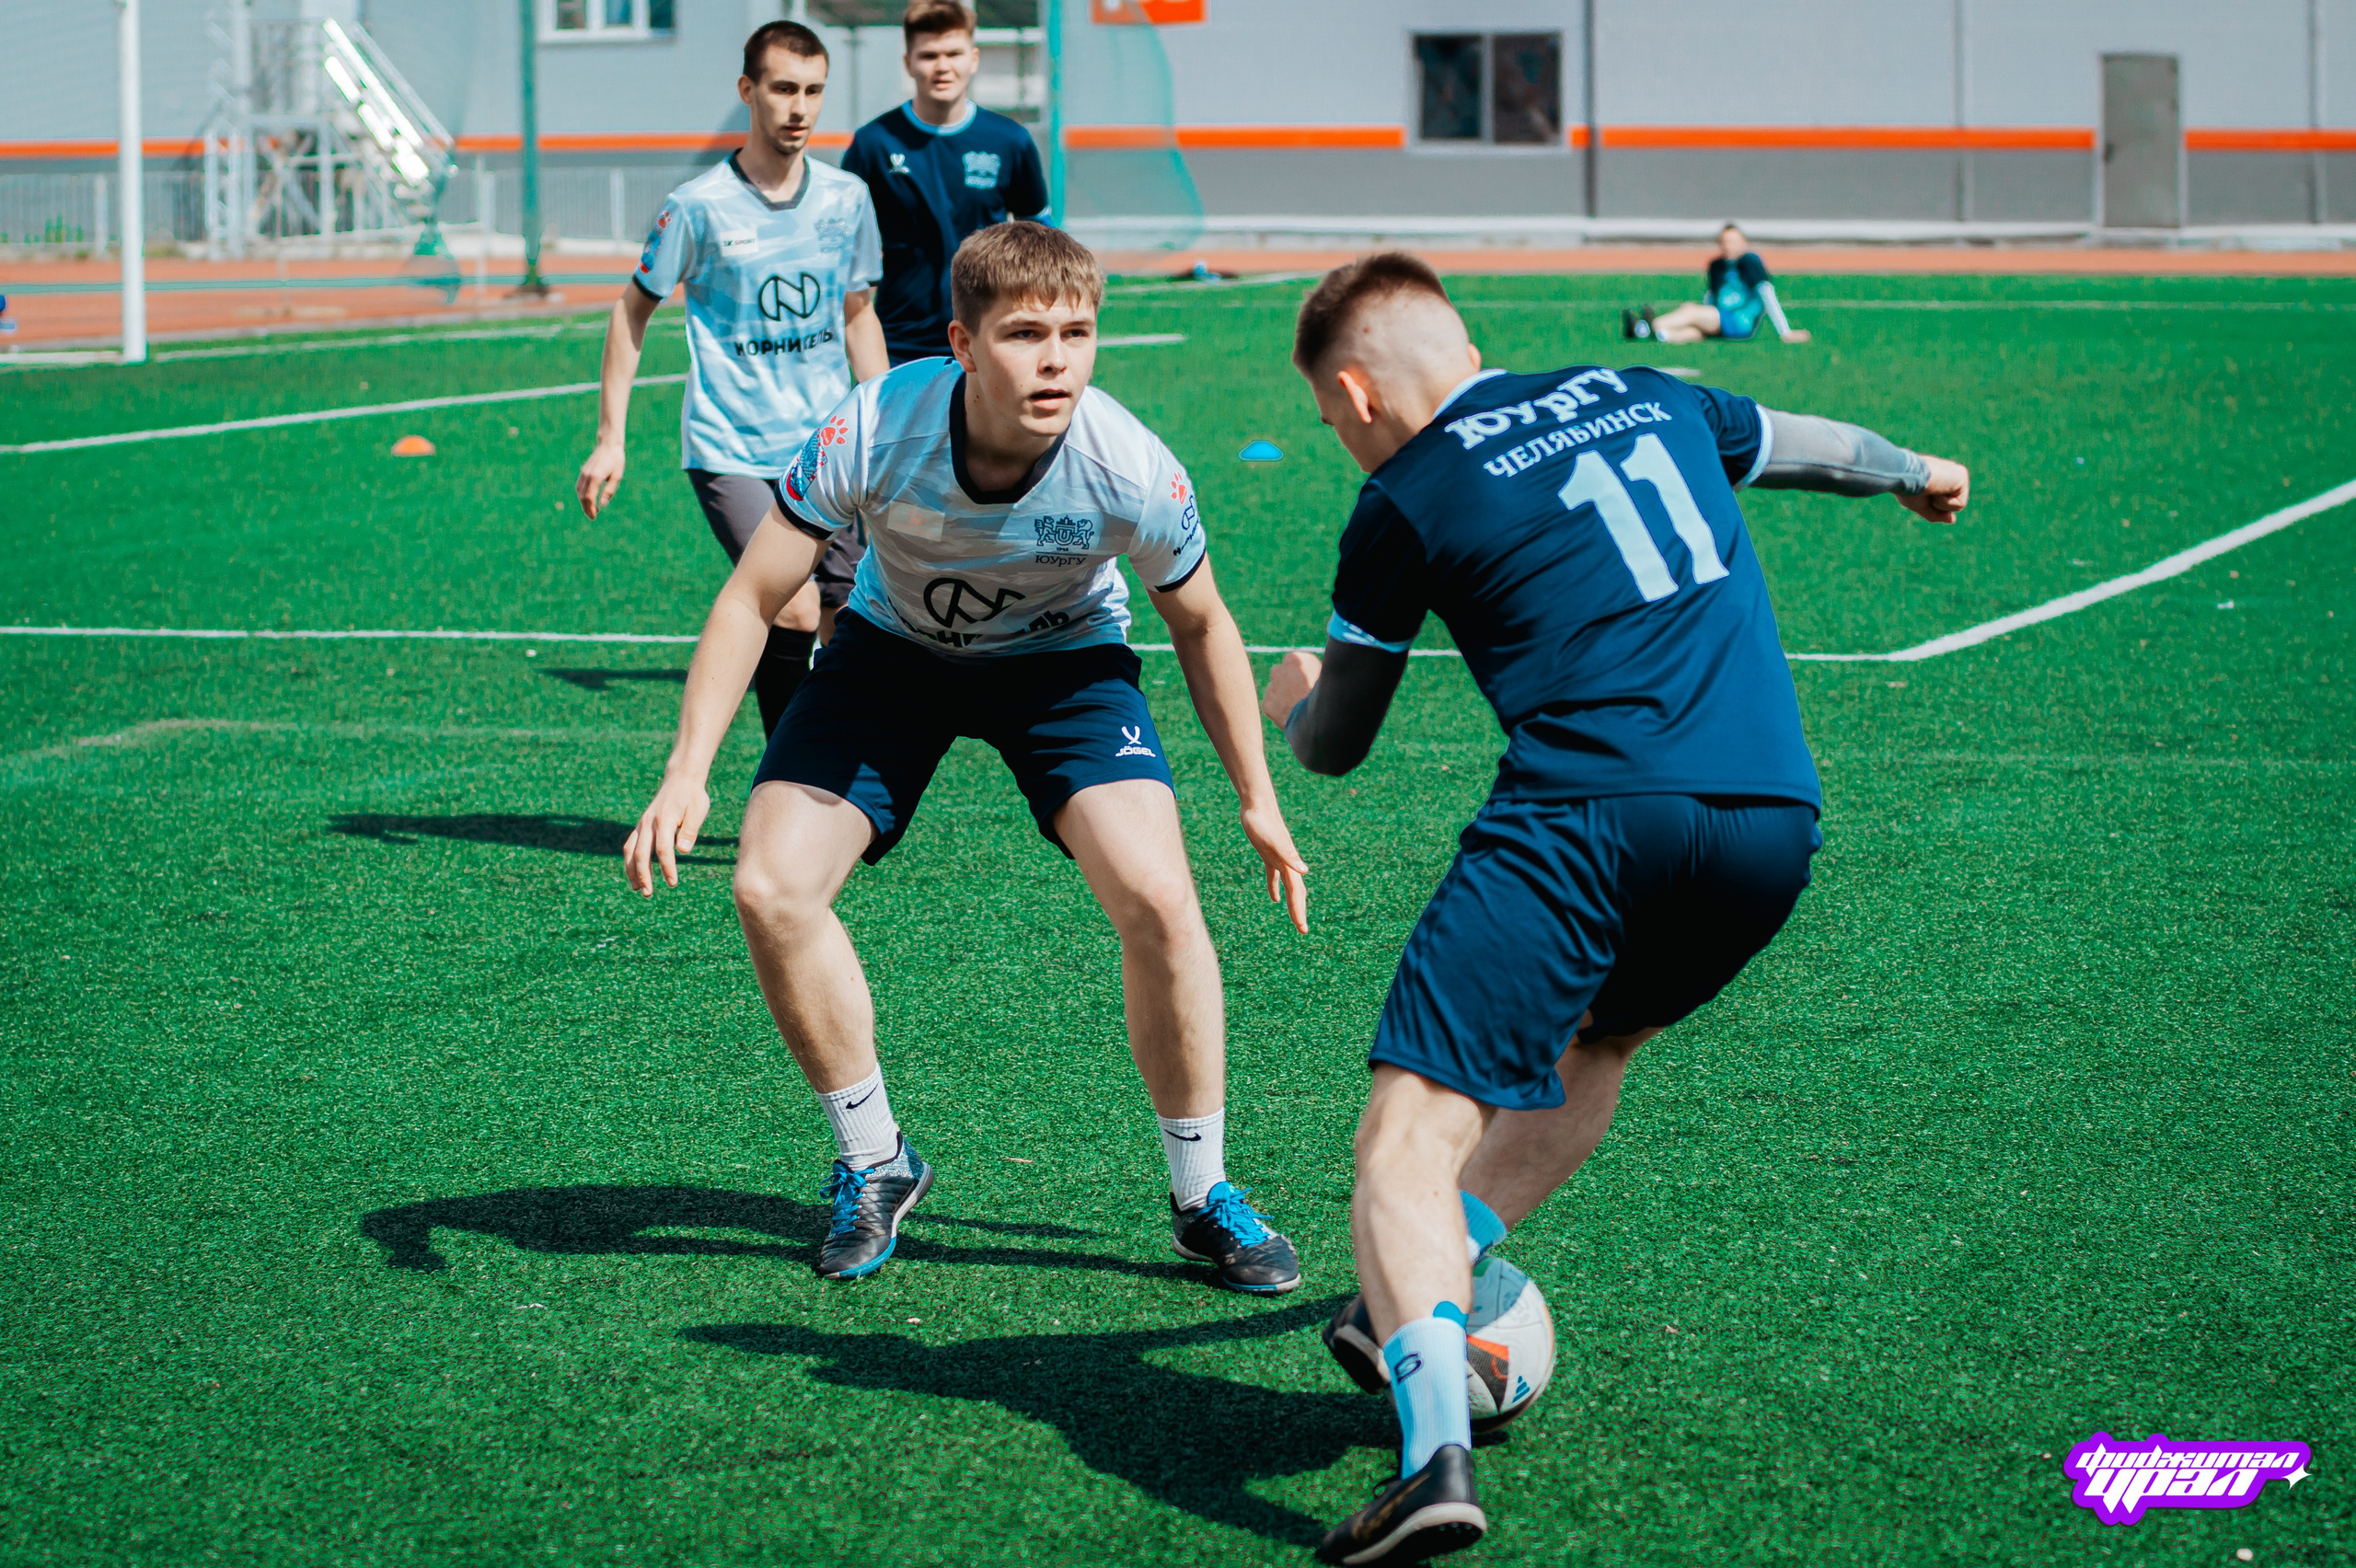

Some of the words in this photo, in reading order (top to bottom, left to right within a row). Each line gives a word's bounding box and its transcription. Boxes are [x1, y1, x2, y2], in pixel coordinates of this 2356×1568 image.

[1484, 401, 1672, 478] ЧЕЛЯБИНСК
[1557, 432, 1730, 603] 11
[1035, 555, 1087, 567] ЮУрГУ
[1115, 745, 1157, 757] JÖGEL
